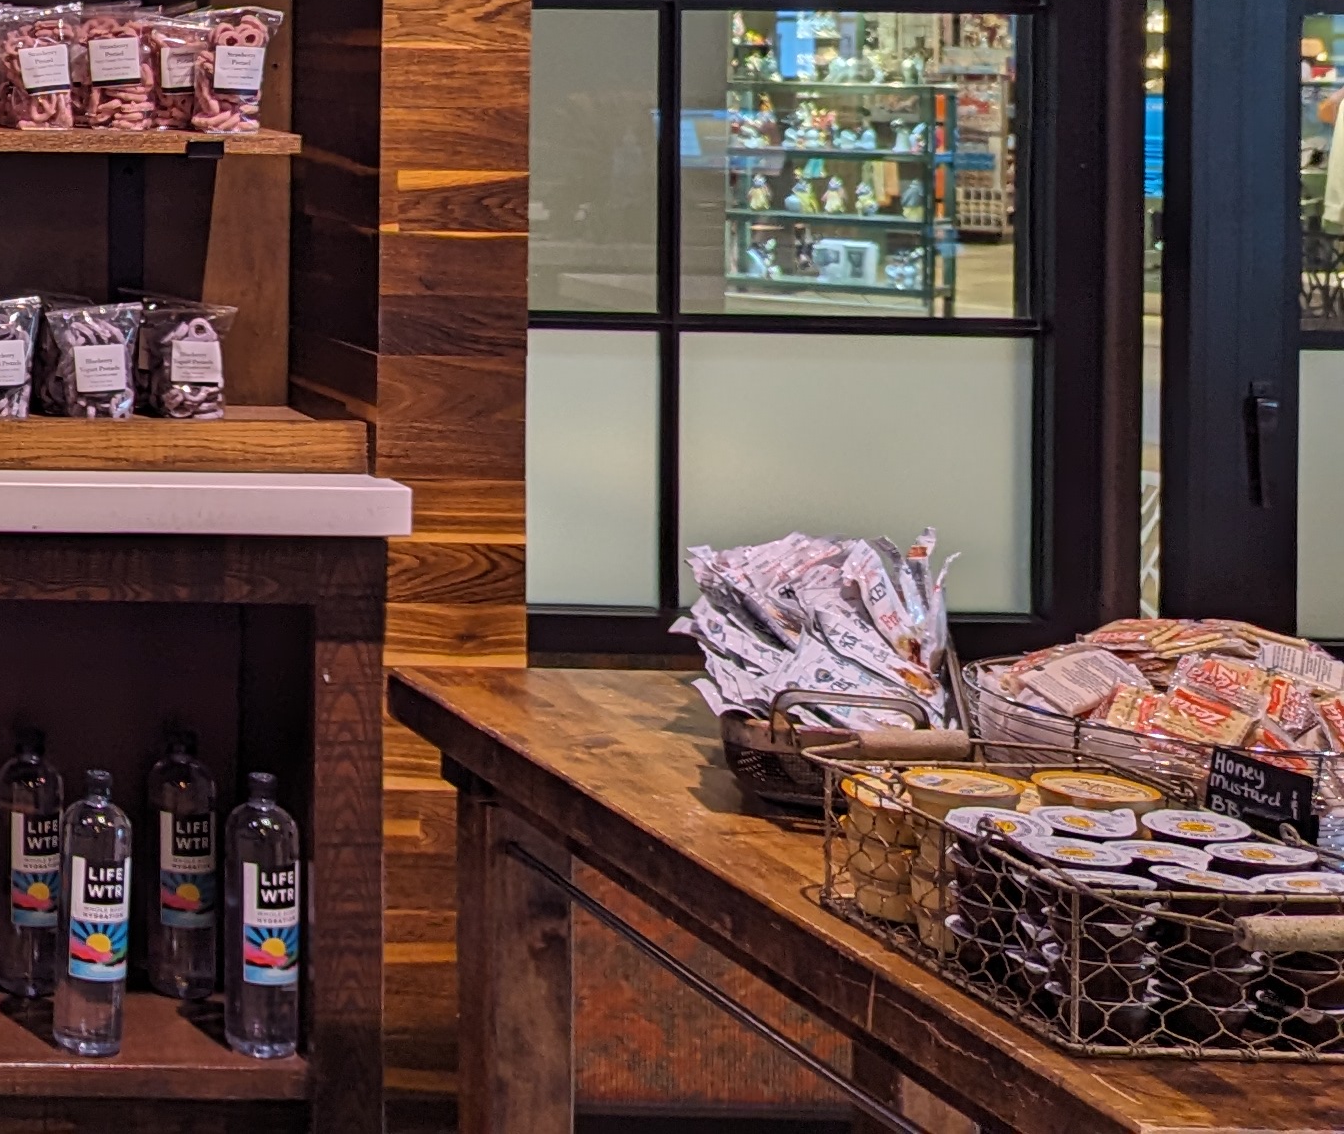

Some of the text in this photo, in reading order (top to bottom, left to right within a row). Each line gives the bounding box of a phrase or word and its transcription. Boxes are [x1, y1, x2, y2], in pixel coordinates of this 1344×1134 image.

[1214, 752, 1265, 789] Honey
[27, 819, 58, 834] LIFE
[176, 820, 209, 834] LIFE
[88, 867, 123, 882] LIFE
[260, 870, 294, 886] LIFE
[87, 884, 123, 899] WTR
[260, 888, 294, 903] WTR
